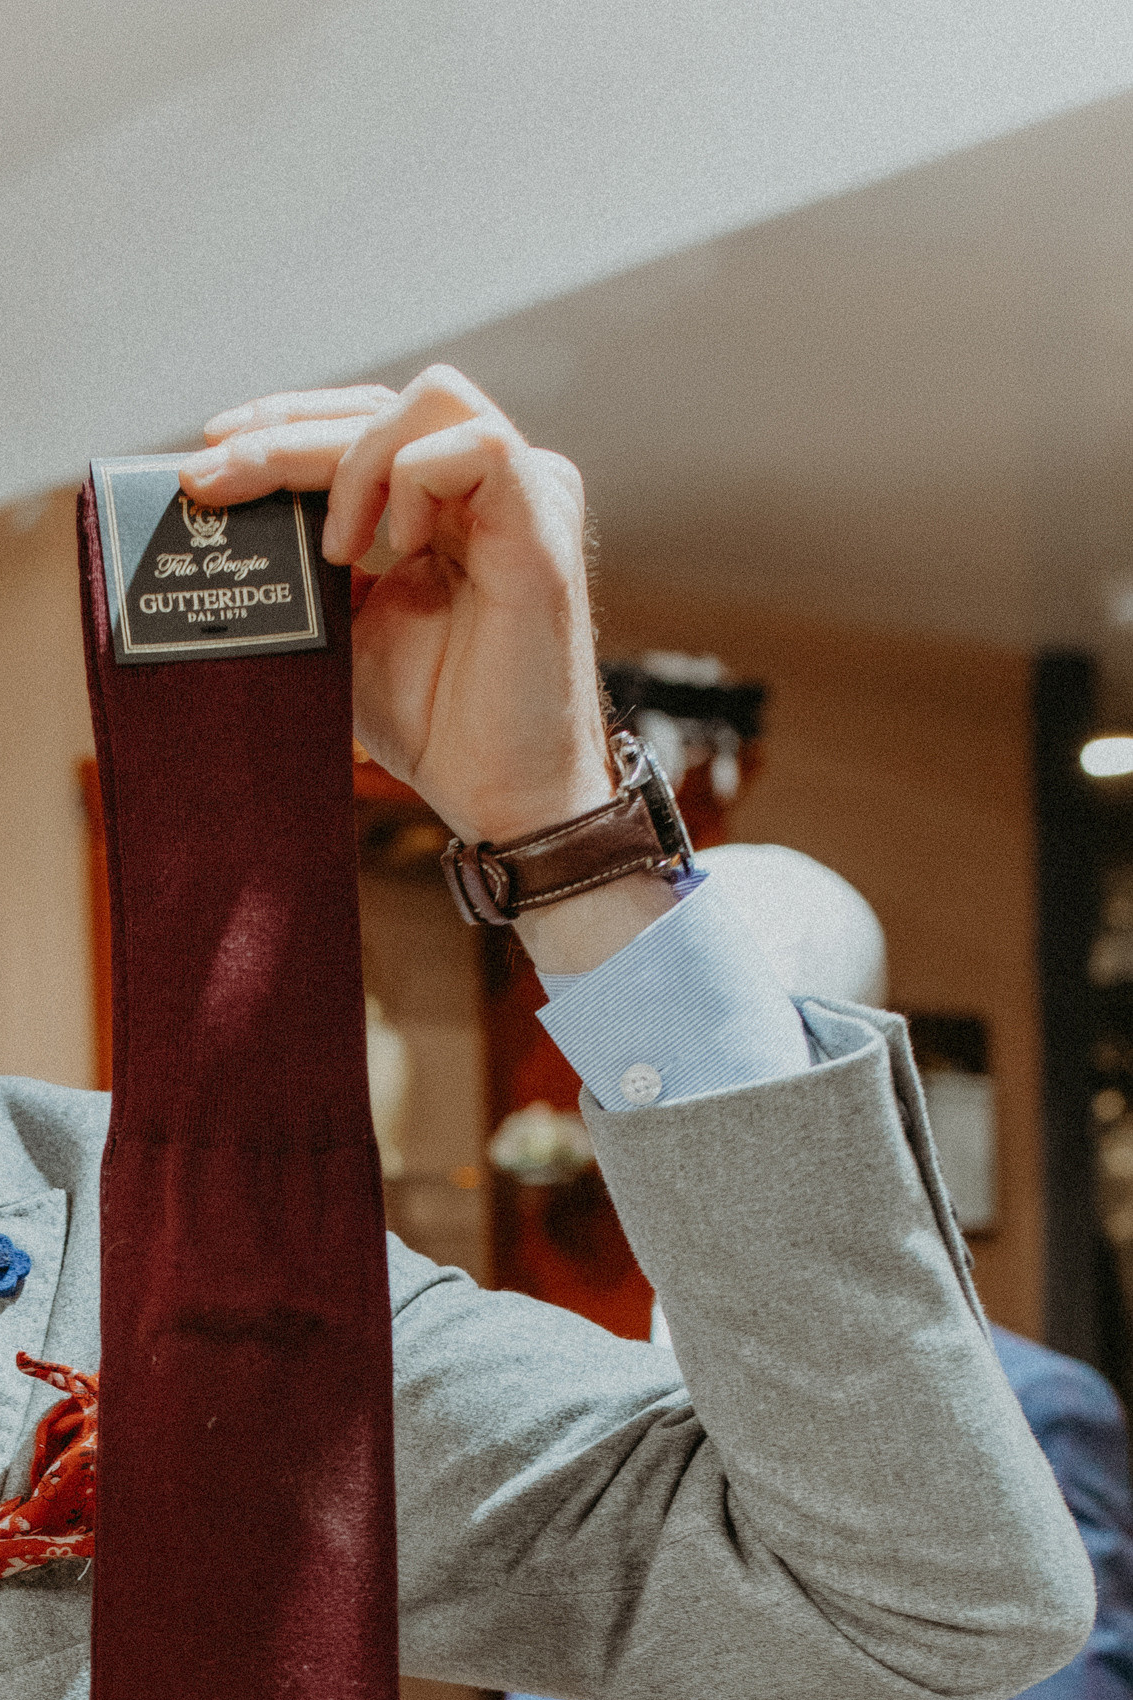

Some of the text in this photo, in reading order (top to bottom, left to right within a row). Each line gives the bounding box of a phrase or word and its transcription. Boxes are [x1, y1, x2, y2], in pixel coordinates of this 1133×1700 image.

[154, 548, 269, 581] Filo Scozia
[139, 582, 292, 614] GUTTERIDGE
[187, 607, 248, 623] DAL 1878
